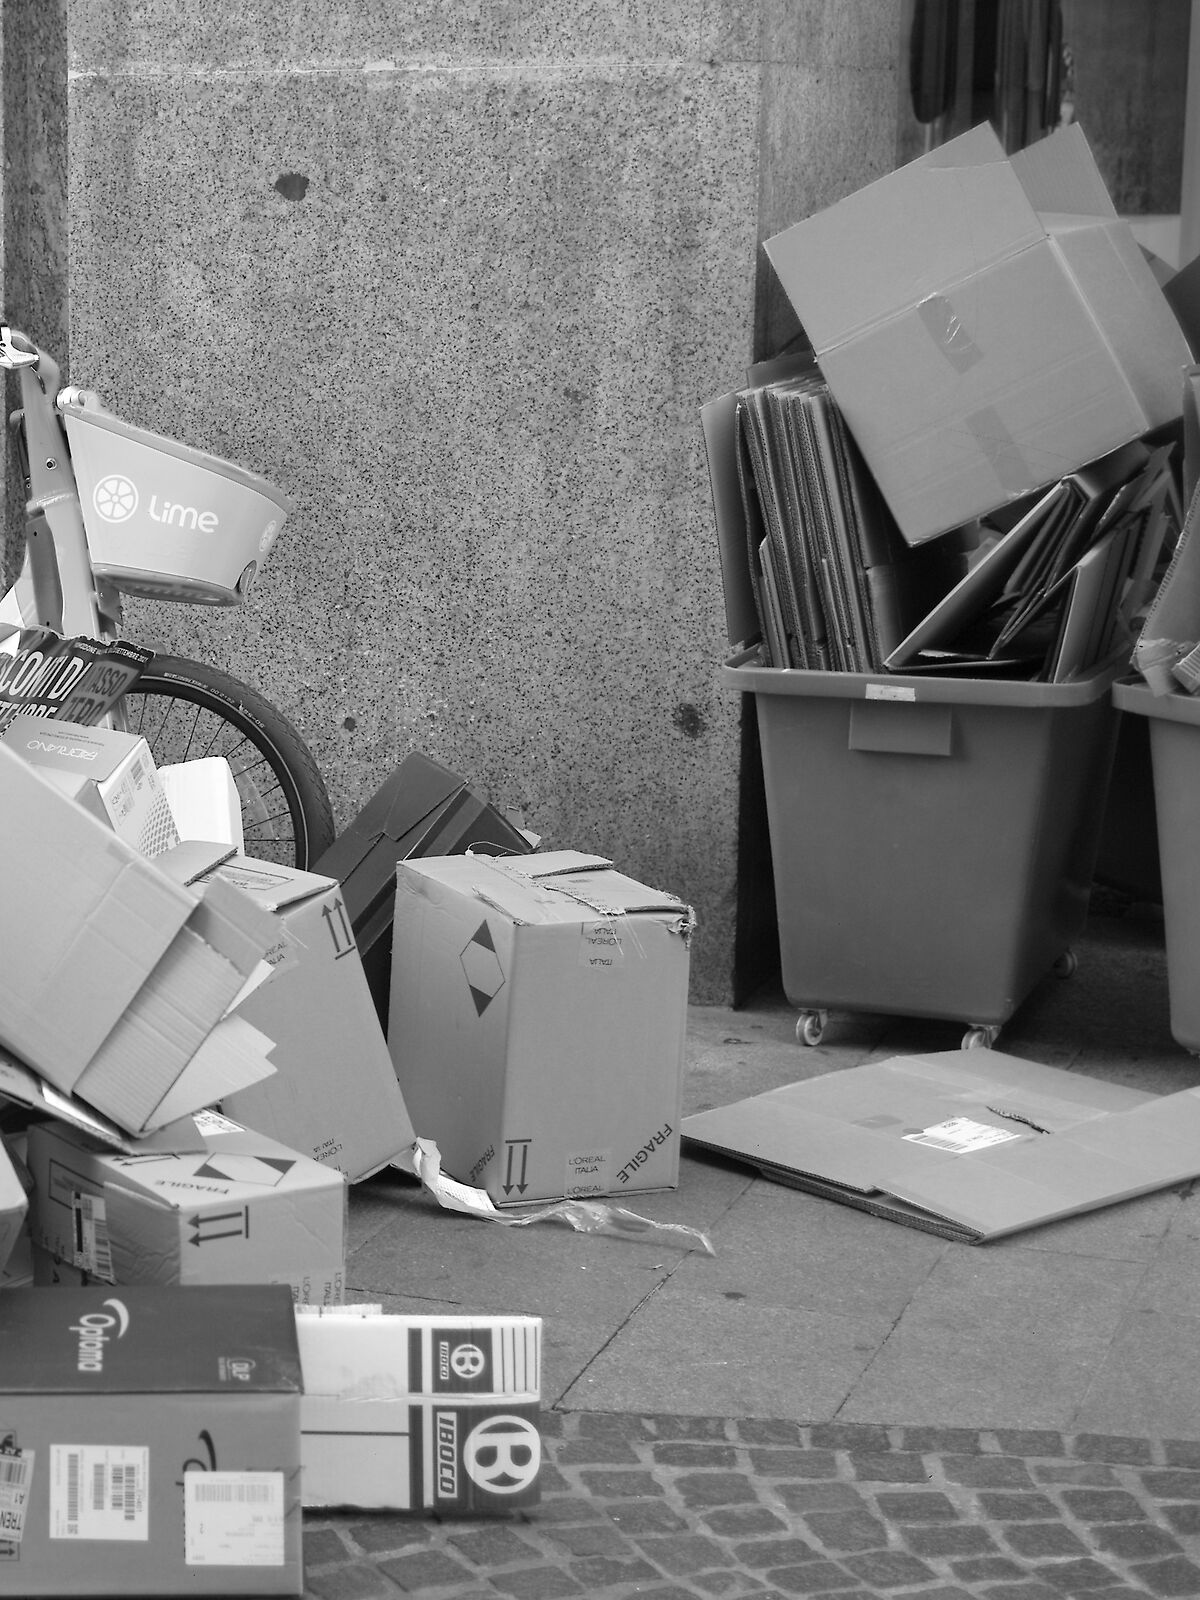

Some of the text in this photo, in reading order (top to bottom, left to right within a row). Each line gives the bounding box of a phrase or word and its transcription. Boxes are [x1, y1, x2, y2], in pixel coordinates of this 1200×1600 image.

[149, 495, 220, 534] Lime
[46, 656, 94, 702] DI
[470, 1143, 496, 1184] FRAGILE
[616, 1122, 674, 1184] FRAGILE
[154, 1179, 231, 1195] FRAGILE
[68, 1313, 117, 1372] Optoma
[440, 1343, 449, 1379] IBOCO
[439, 1416, 455, 1495] IBOCO
